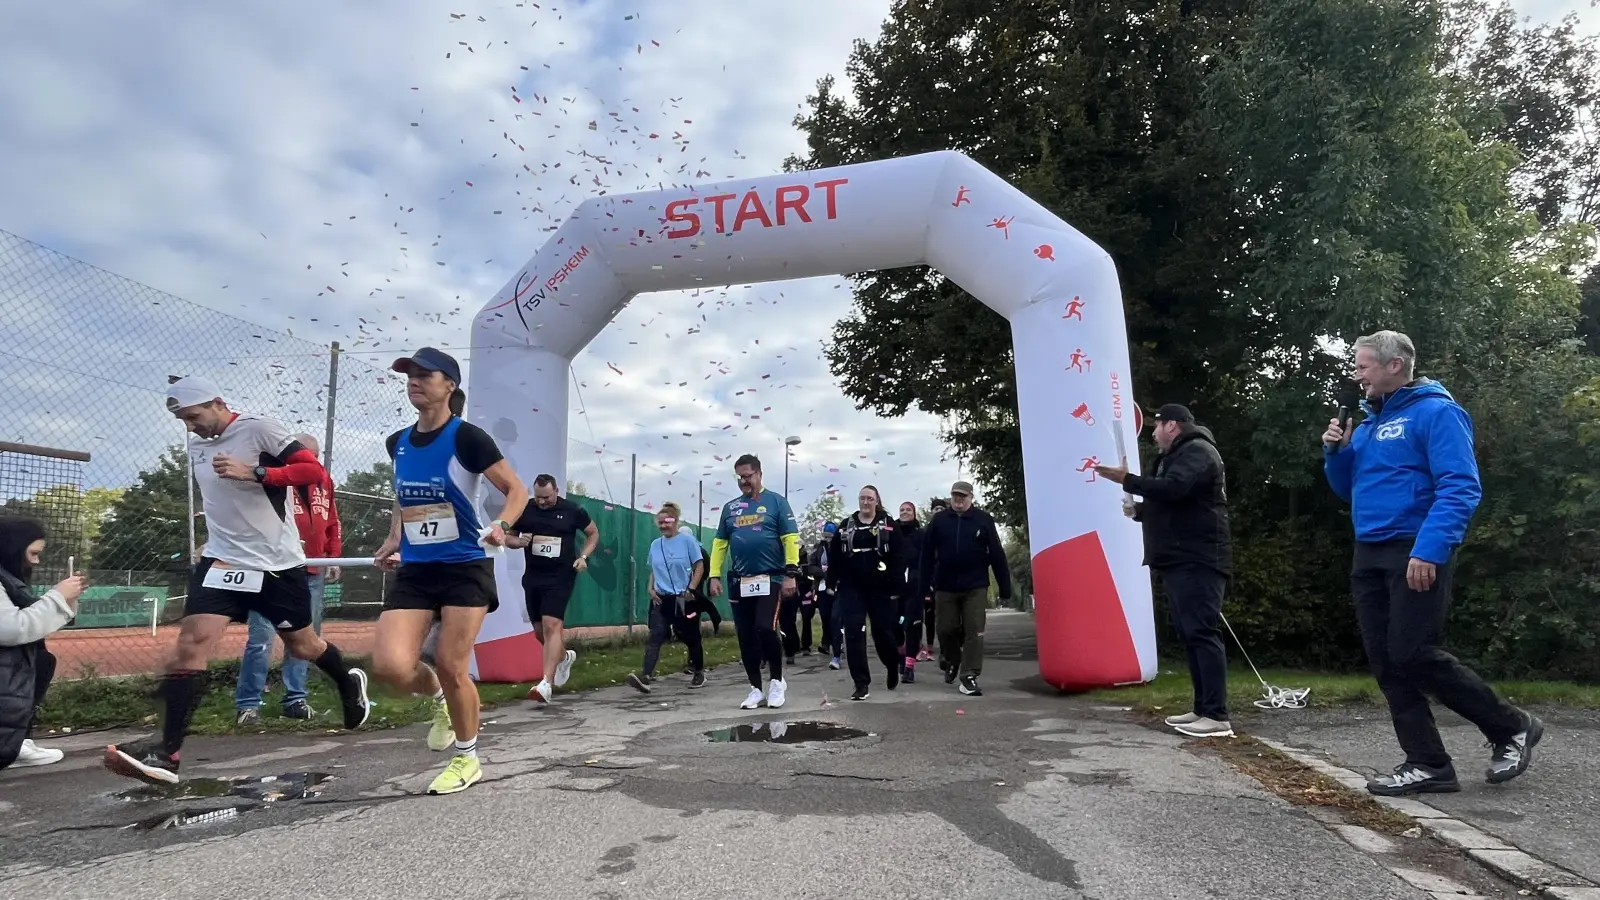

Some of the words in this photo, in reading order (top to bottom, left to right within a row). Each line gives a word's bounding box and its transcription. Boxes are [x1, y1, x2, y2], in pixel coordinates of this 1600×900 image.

[664, 178, 848, 239] START
[523, 288, 546, 311] TSV
[545, 245, 590, 293] IPSHEIM
[419, 521, 439, 538] 47
[540, 544, 552, 554] 20
[222, 571, 245, 585] 50
[749, 583, 761, 593] 34
